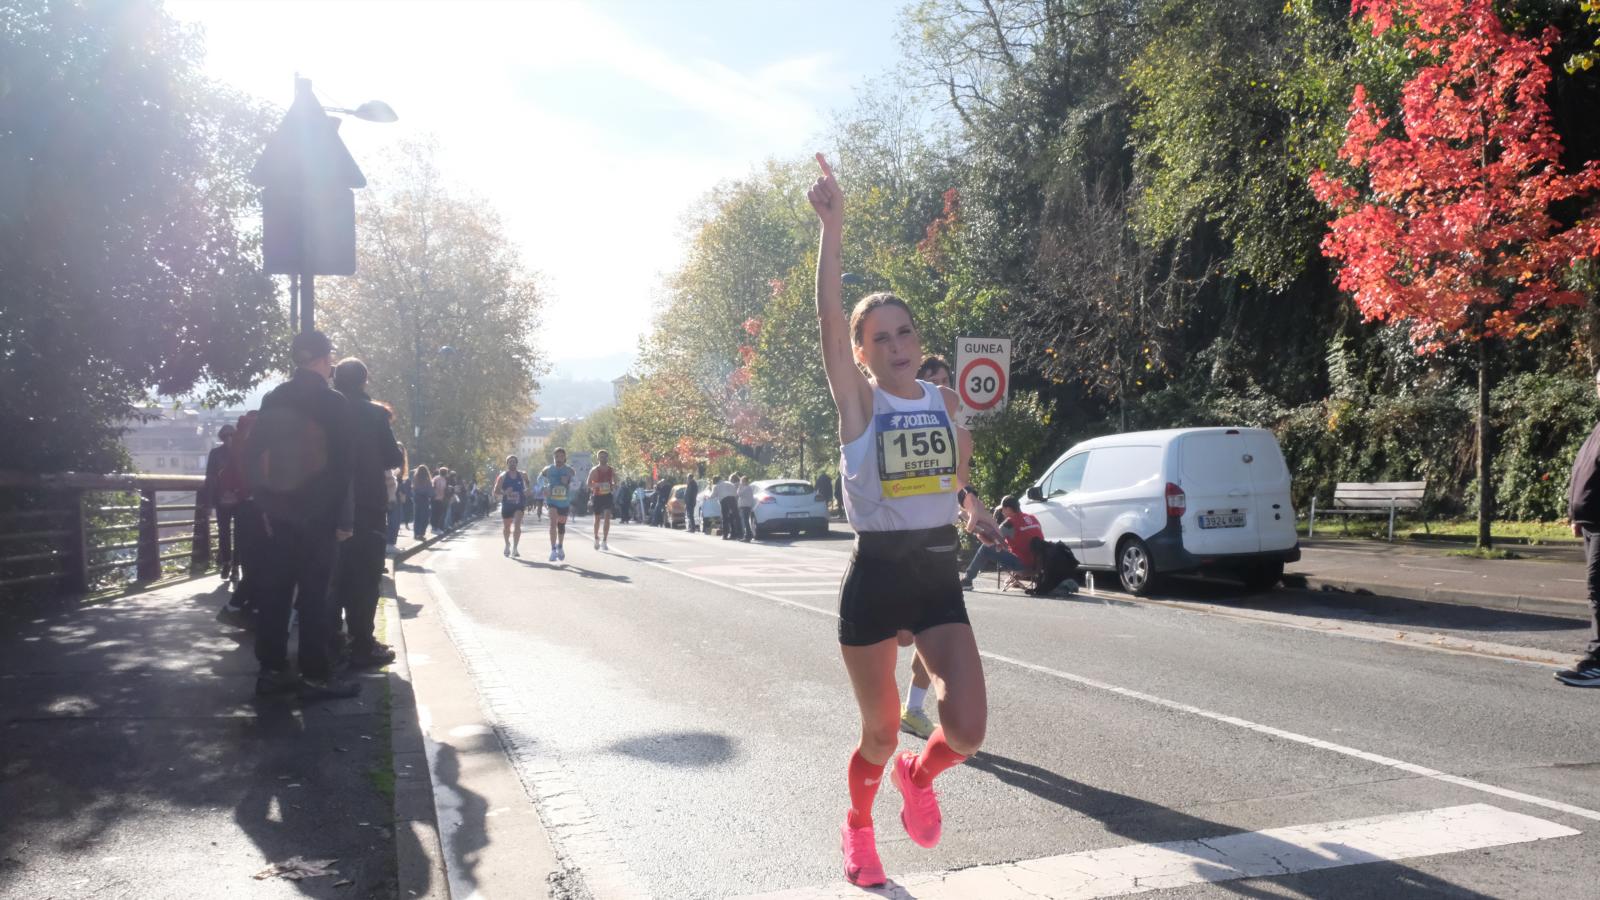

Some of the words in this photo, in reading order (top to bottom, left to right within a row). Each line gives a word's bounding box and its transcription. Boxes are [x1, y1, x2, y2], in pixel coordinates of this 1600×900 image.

[964, 343, 1004, 353] GUNEA
[970, 376, 996, 393] 30
[893, 431, 947, 457] 156
[904, 460, 939, 470] ESTEFI
